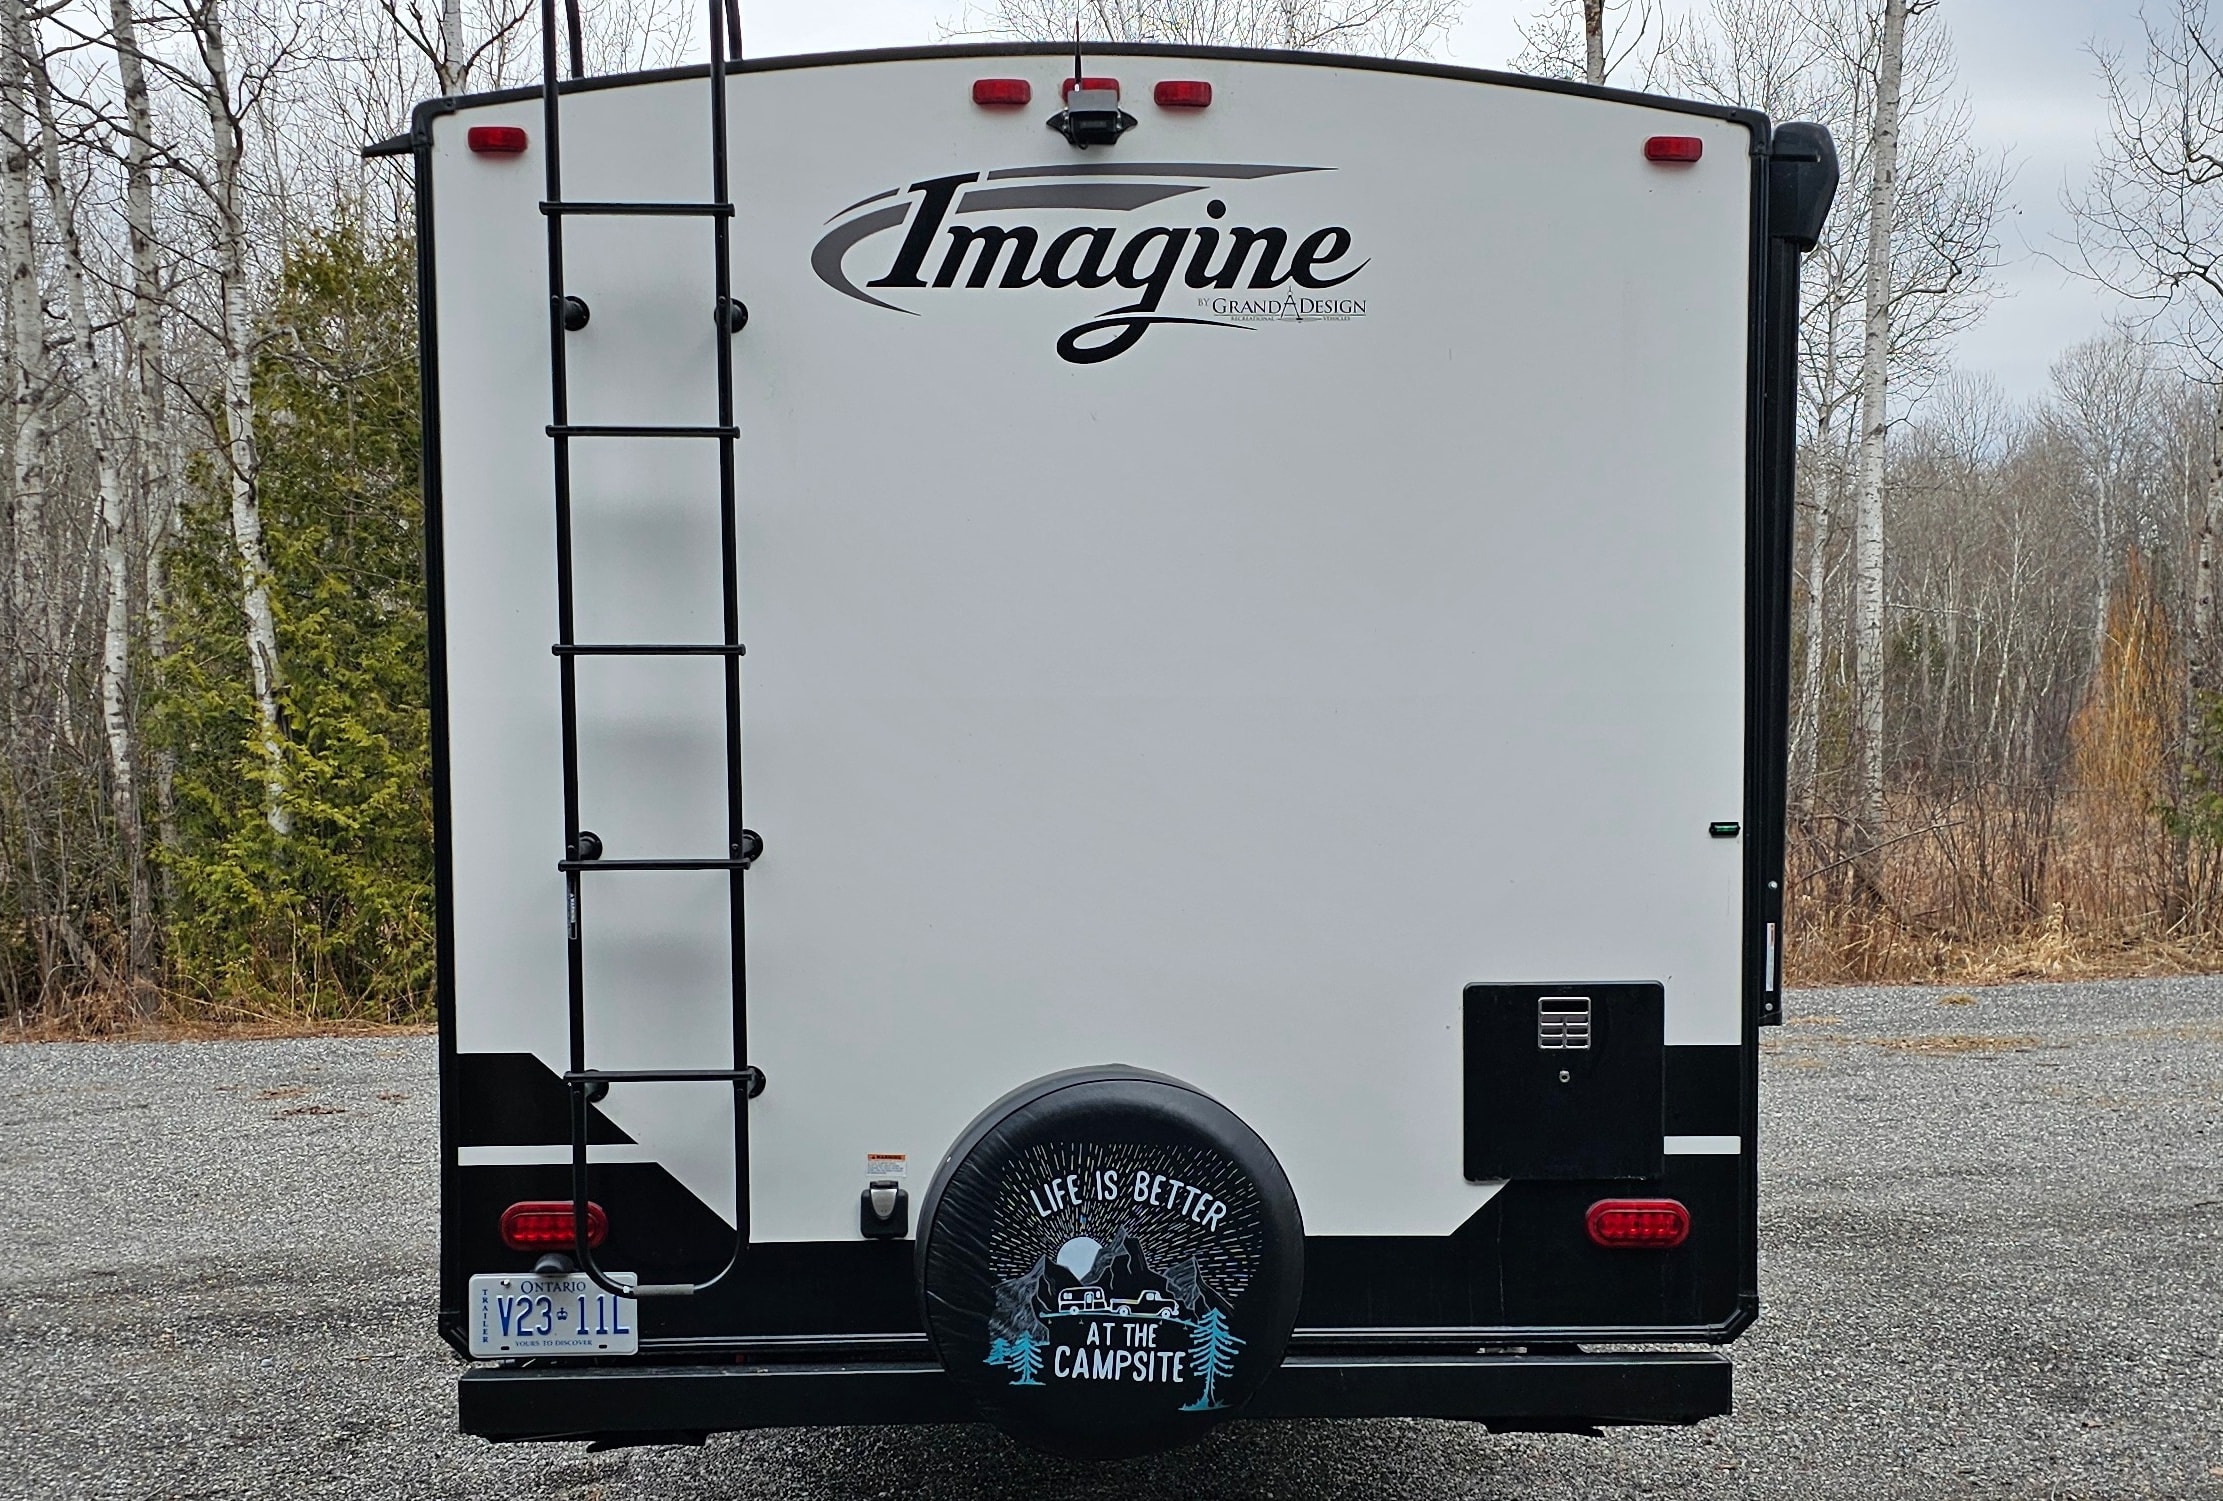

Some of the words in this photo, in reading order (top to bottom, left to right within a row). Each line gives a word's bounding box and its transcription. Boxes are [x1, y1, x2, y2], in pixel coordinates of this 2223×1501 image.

[866, 171, 1371, 364] Imagine
[1198, 298, 1210, 306] BY
[1212, 297, 1281, 314] GRAND
[1300, 297, 1367, 314] DESIGN
[1030, 1174, 1083, 1218] LIFE
[1095, 1170, 1119, 1202] IS
[1133, 1170, 1227, 1232] BETTER
[520, 1280, 586, 1294] ONTARIO
[481, 1288, 490, 1344] TRAILER
[496, 1295, 552, 1336] V23
[577, 1295, 630, 1336] 11L
[1086, 1321, 1116, 1346] AT
[1122, 1322, 1158, 1348] THE
[1053, 1345, 1187, 1383] CAMPSITE
